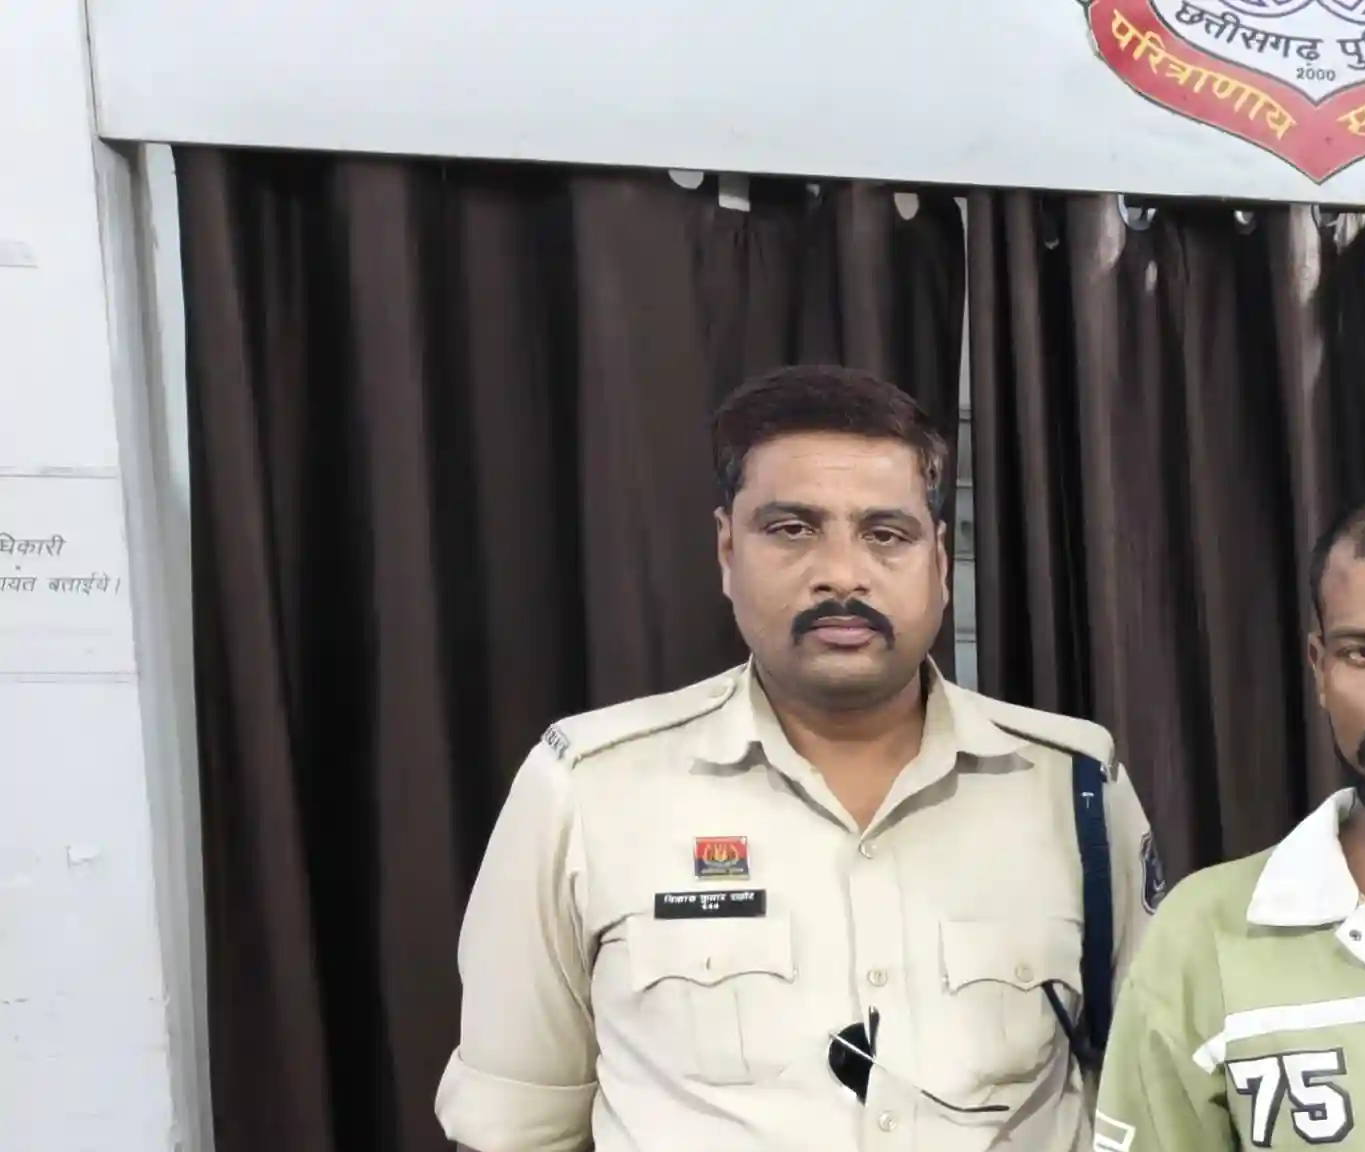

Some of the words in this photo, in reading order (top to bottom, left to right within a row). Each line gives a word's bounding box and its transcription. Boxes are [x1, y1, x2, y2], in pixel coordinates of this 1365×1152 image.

[1174, 3, 1324, 65] छत्तीसगढ़
[1296, 67, 1336, 82] 2000
[1111, 9, 1299, 141] परित्राणाय
[1226, 1047, 1353, 1148] 75
